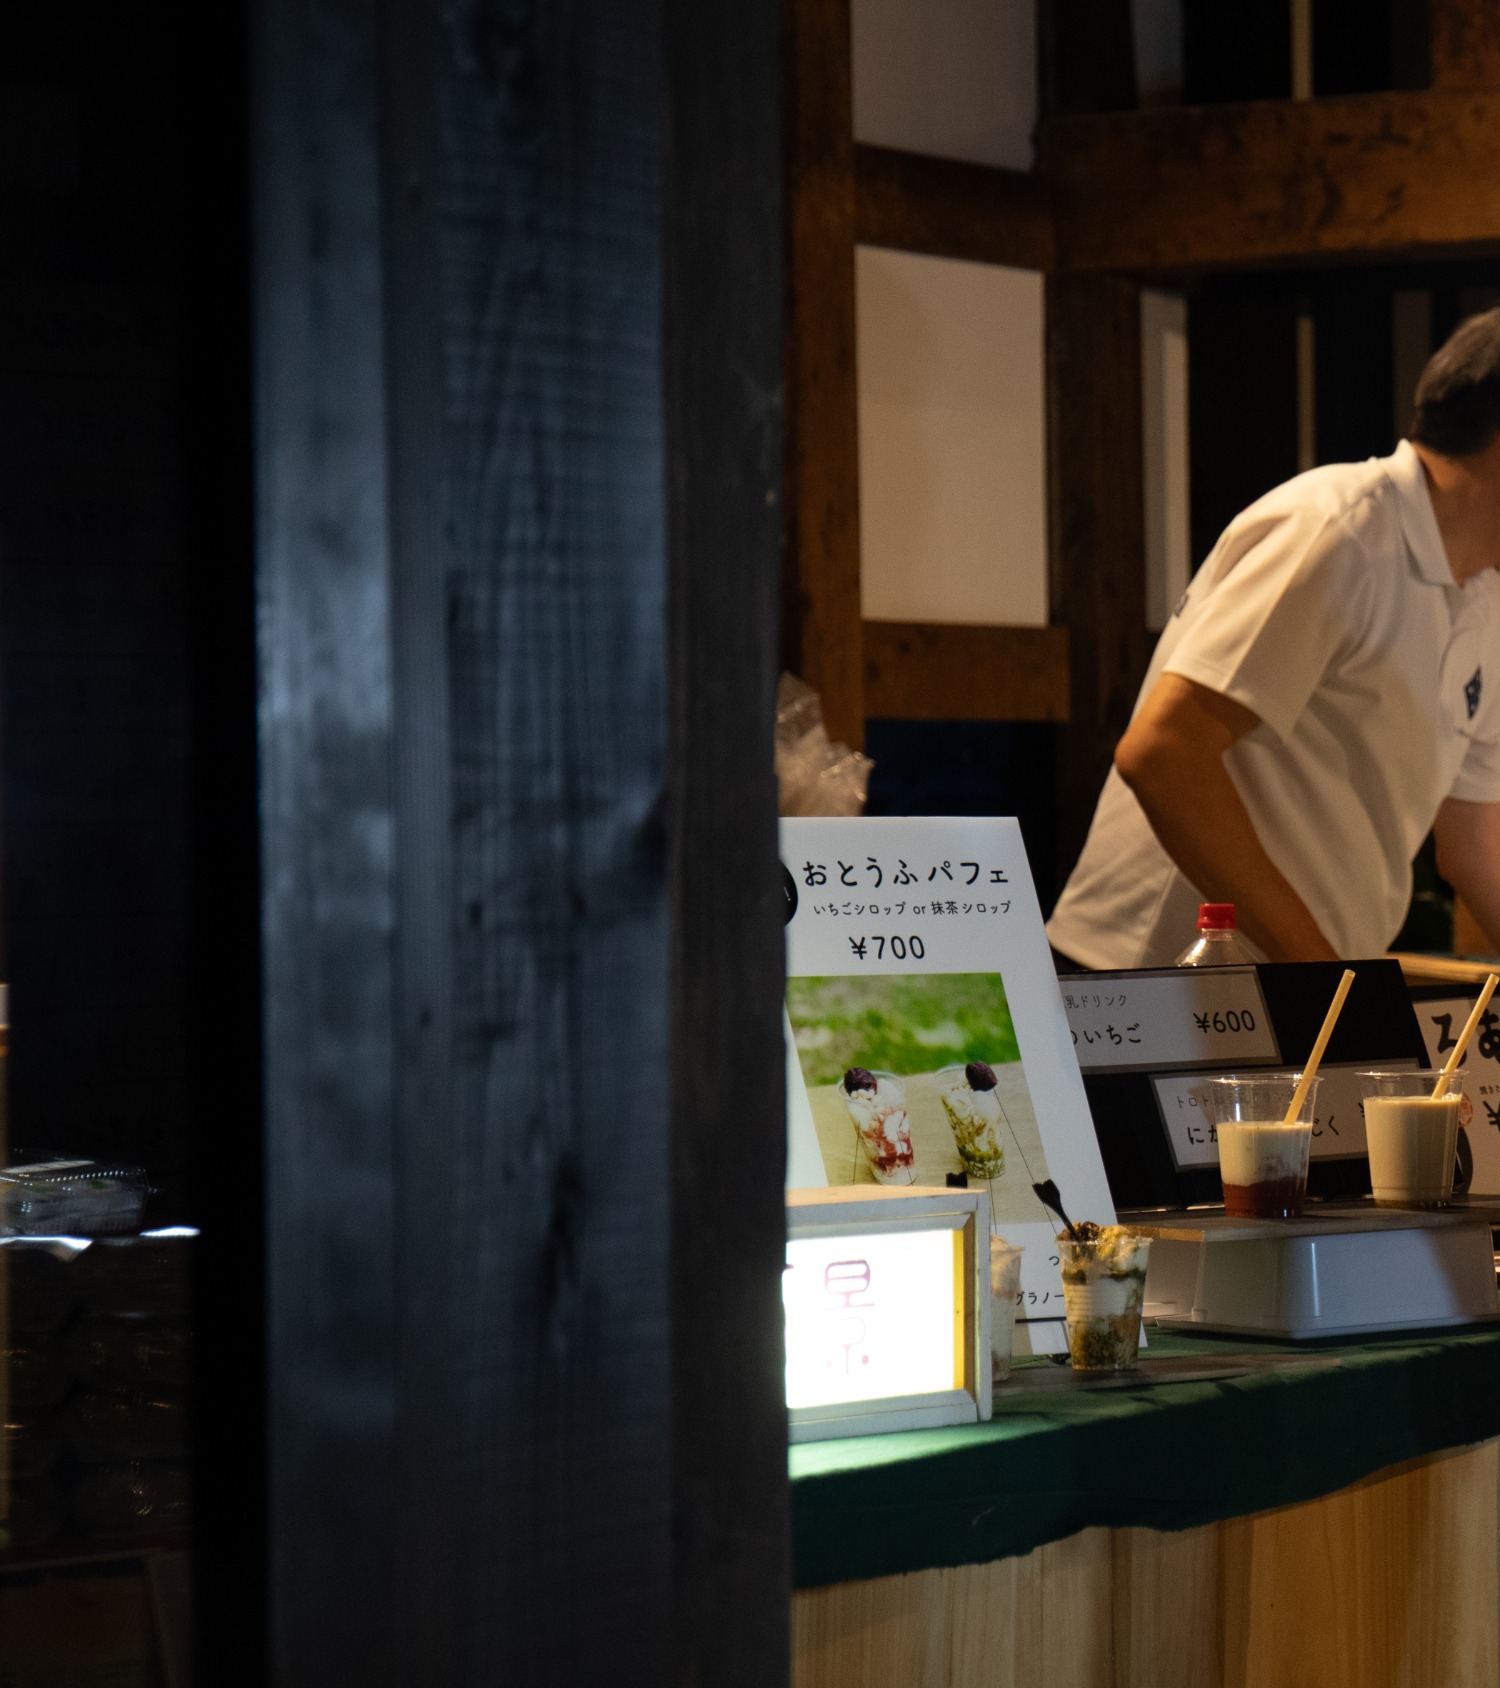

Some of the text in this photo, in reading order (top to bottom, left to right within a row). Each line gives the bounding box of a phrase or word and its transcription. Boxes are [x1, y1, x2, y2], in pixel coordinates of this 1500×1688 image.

[803, 857, 1010, 888] おとうふパフェ
[813, 900, 1012, 917] いちごシロップ or 抹茶シロップ
[848, 934, 926, 961] ¥700
[1064, 994, 1127, 1010] 乳ドリンク
[1193, 1009, 1256, 1034] ¥600
